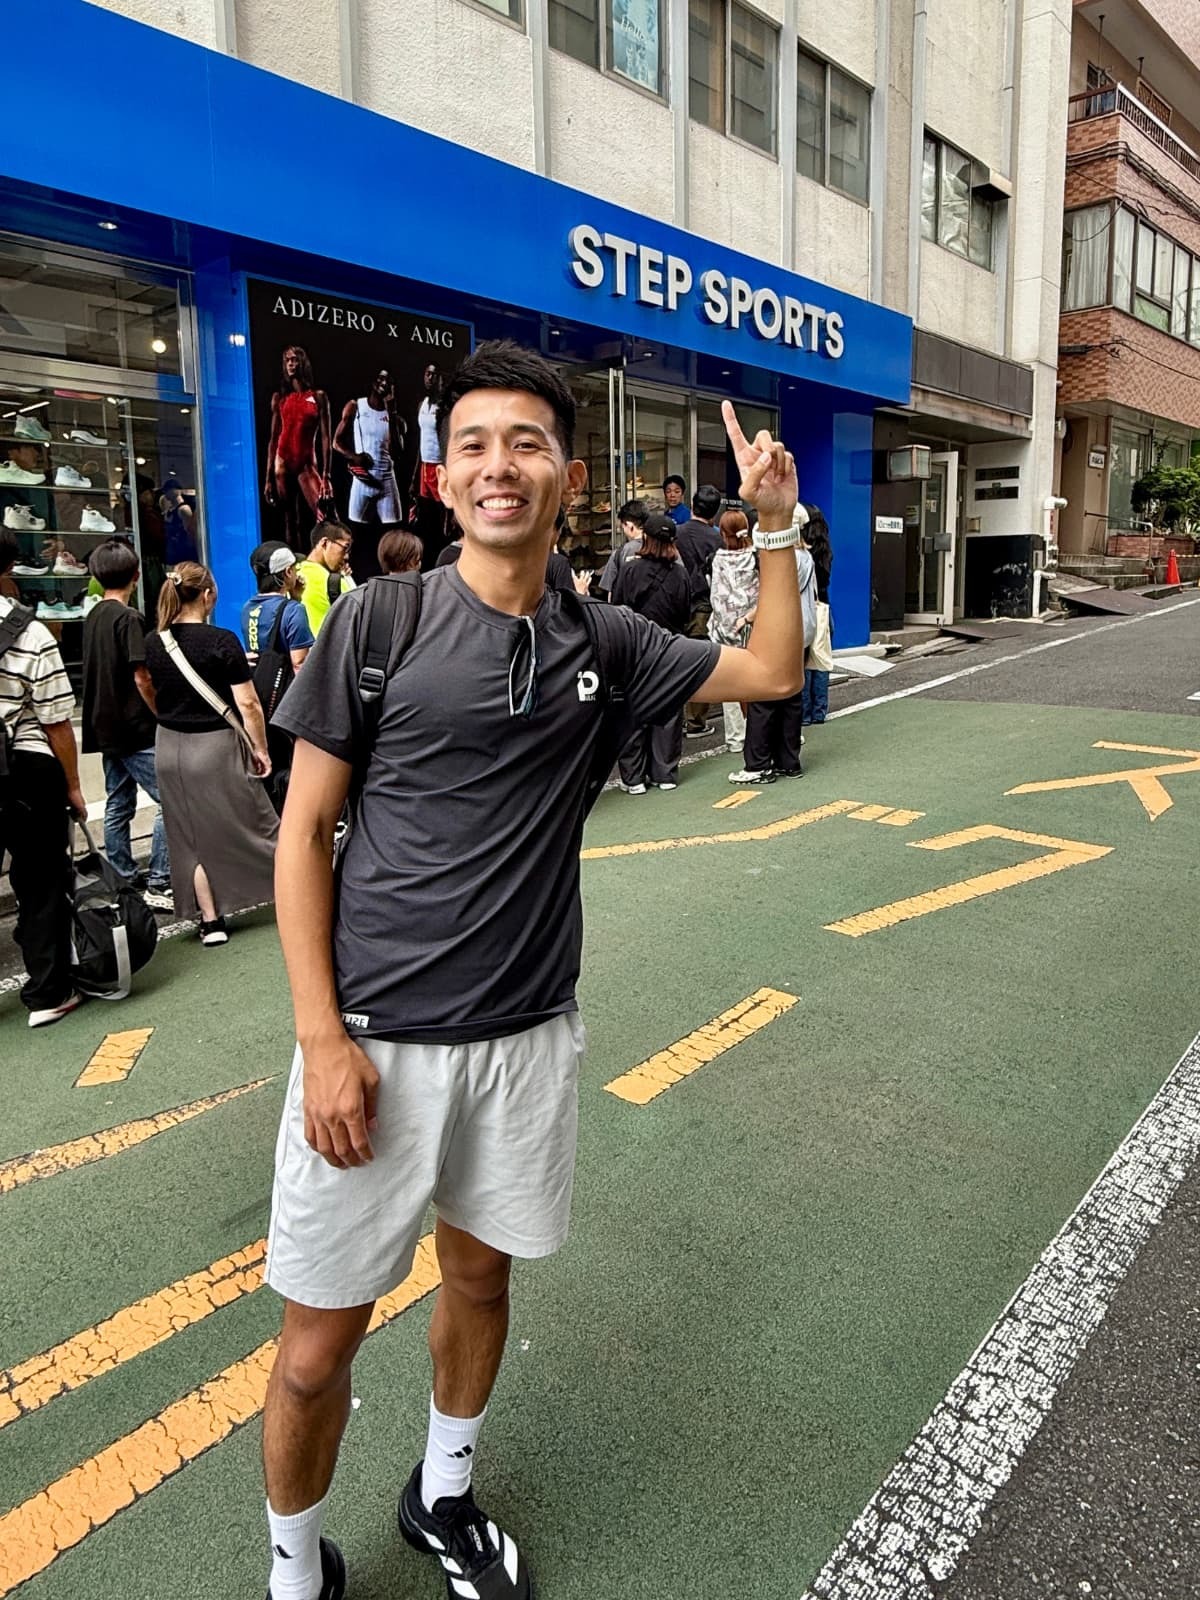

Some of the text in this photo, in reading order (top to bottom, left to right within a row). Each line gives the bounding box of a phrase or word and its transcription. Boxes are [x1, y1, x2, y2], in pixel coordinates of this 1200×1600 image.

[569, 224, 844, 359] STEP SPORTS
[272, 296, 375, 333] ADIZERO
[410, 325, 454, 349] AMG
[248, 617, 260, 650] 2025
